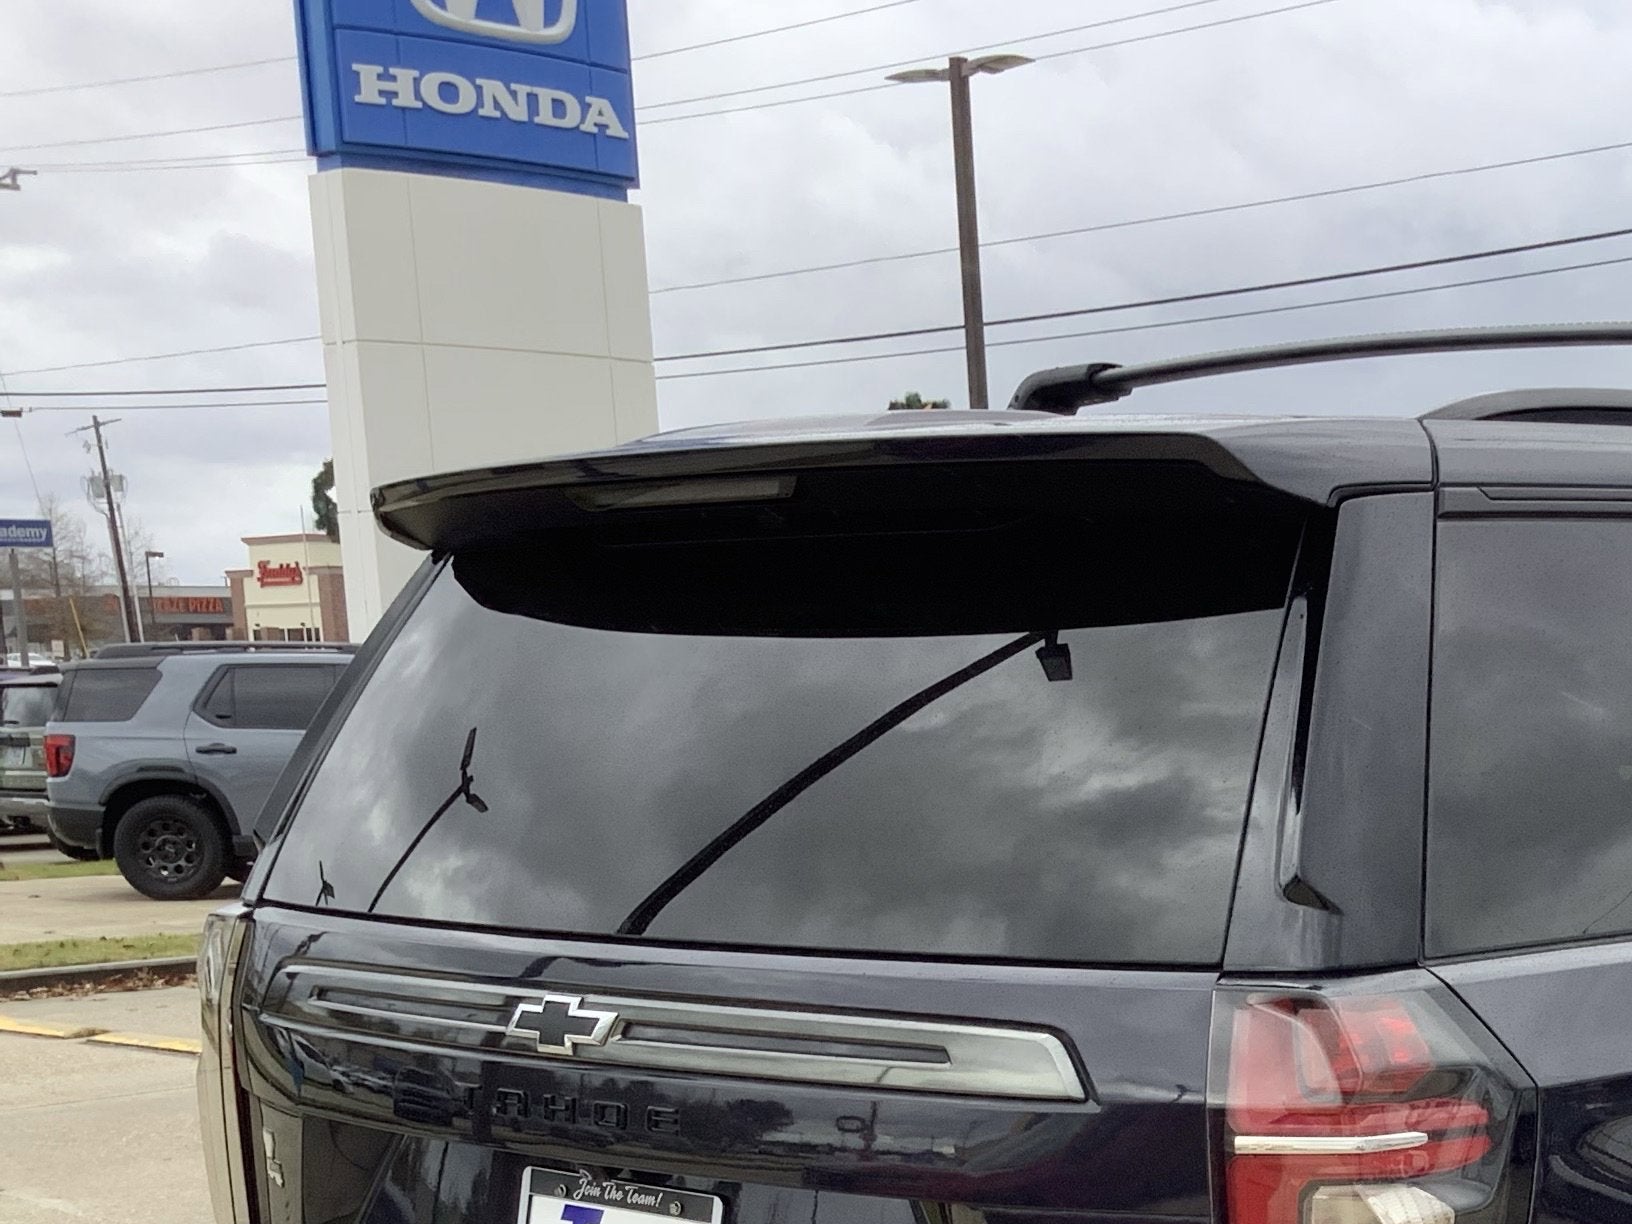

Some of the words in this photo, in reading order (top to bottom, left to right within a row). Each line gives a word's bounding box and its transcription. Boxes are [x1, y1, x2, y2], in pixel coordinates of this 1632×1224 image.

[351, 62, 630, 140] HONDA
[453, 1080, 682, 1137] TAHOE
[573, 1178, 601, 1201] Join
[602, 1181, 624, 1201] The
[625, 1185, 663, 1208] Team!
